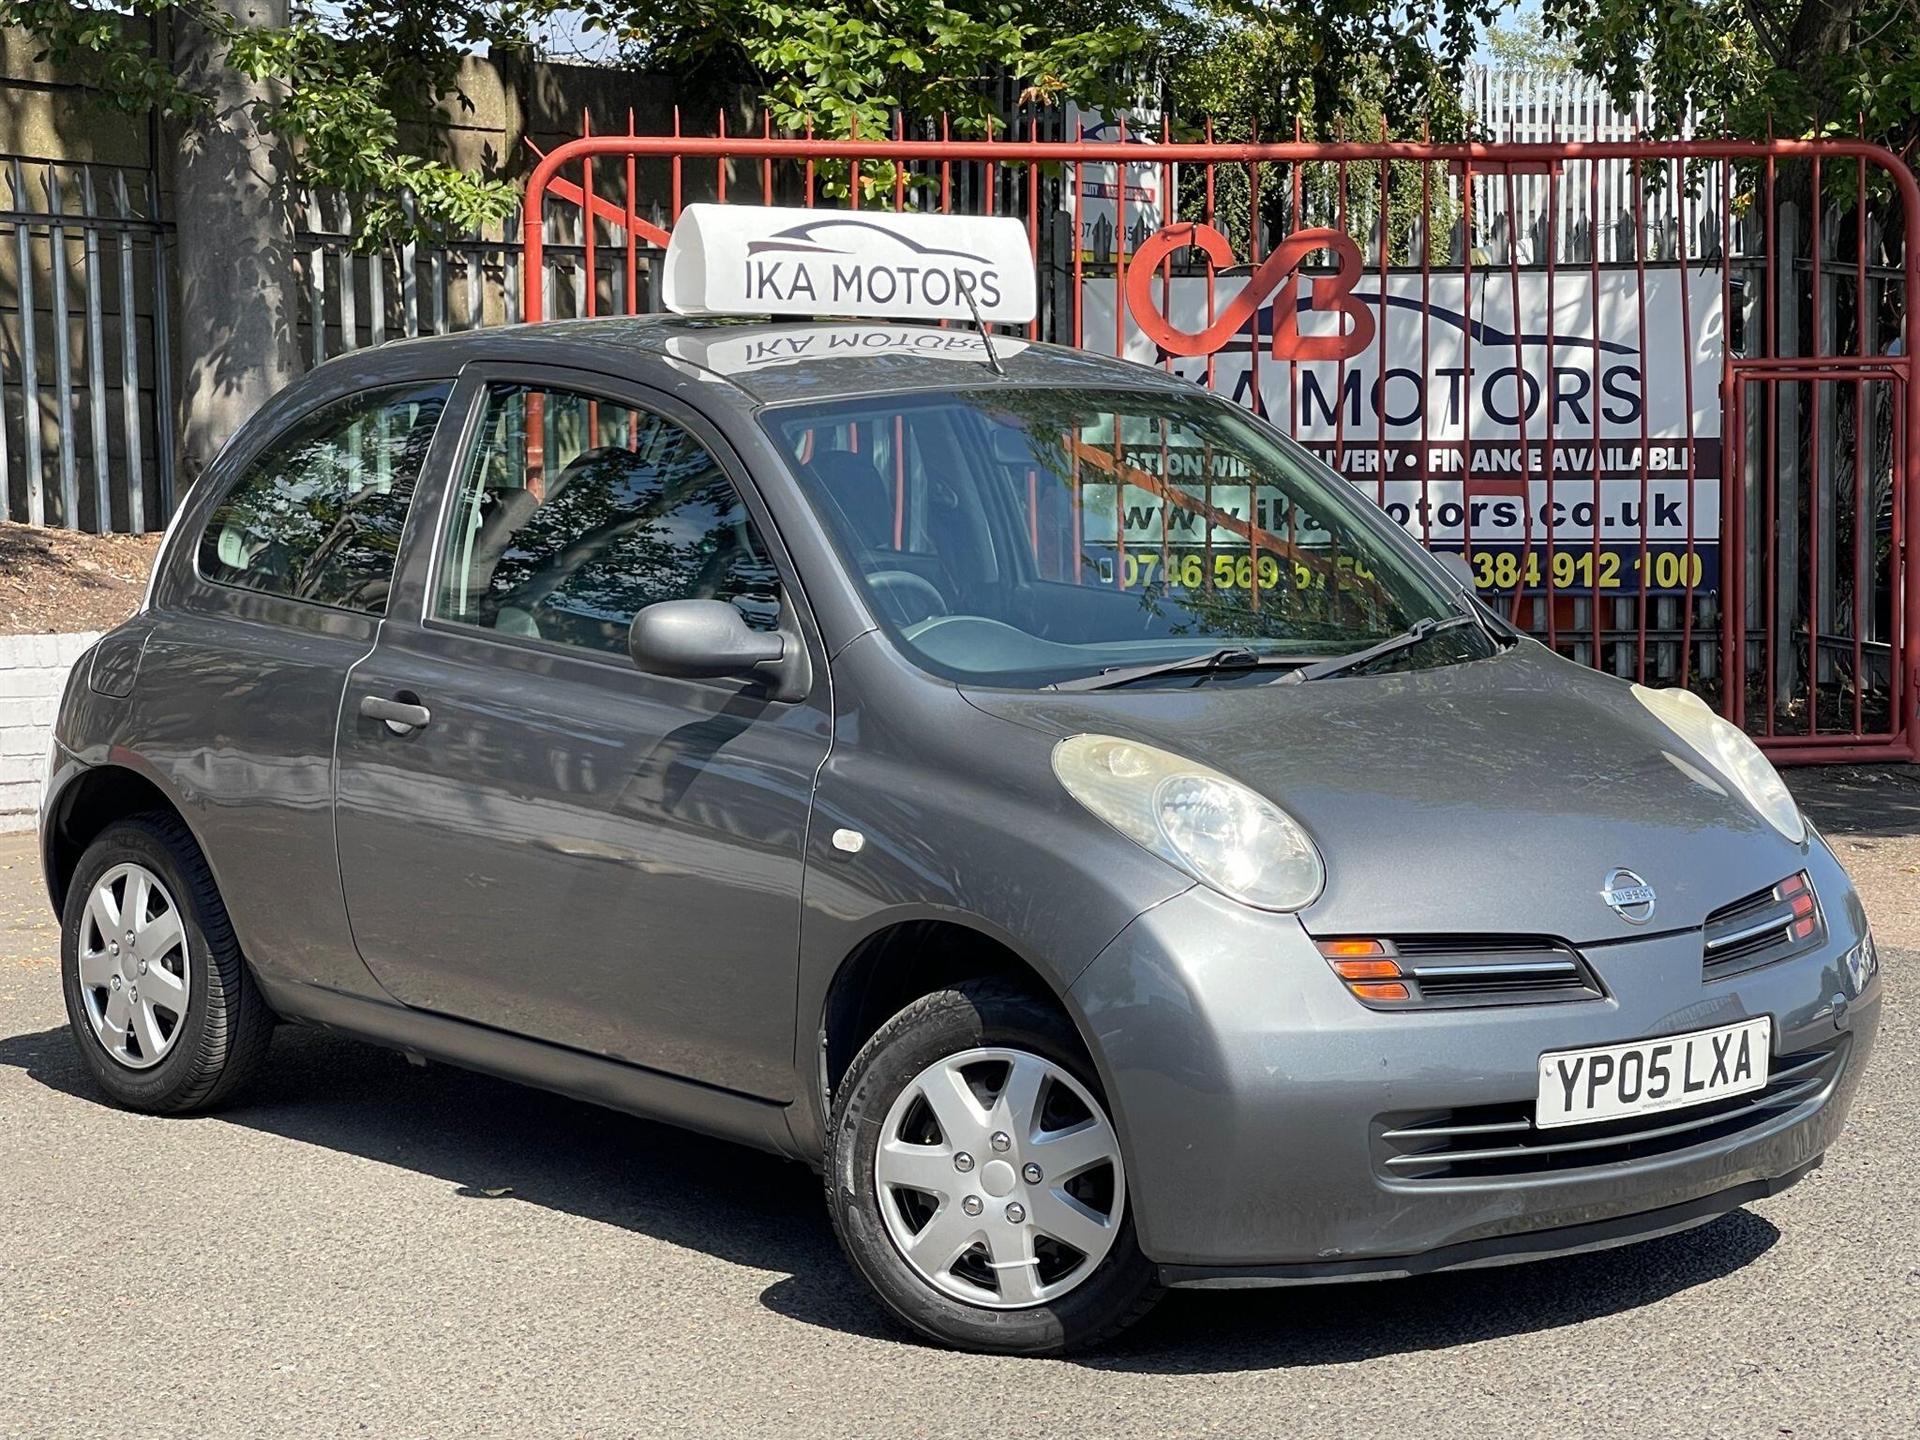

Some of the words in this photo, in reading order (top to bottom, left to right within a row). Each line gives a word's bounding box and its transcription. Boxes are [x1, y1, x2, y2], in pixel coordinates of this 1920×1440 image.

[745, 260, 817, 301] IKA
[832, 264, 1001, 308] MOTORS
[1301, 365, 1643, 427] MOTORS
[1428, 448, 1542, 473] FINANCE
[1552, 446, 1696, 472] AVAILABLE
[1122, 553, 1203, 588] 0746
[1213, 554, 1279, 589] 569
[1552, 552, 1621, 588] 912
[1634, 552, 1703, 588] 100
[1611, 888, 1654, 903] NISSAN
[1557, 1044, 1673, 1112] YP05
[1682, 1029, 1752, 1094] LXA
